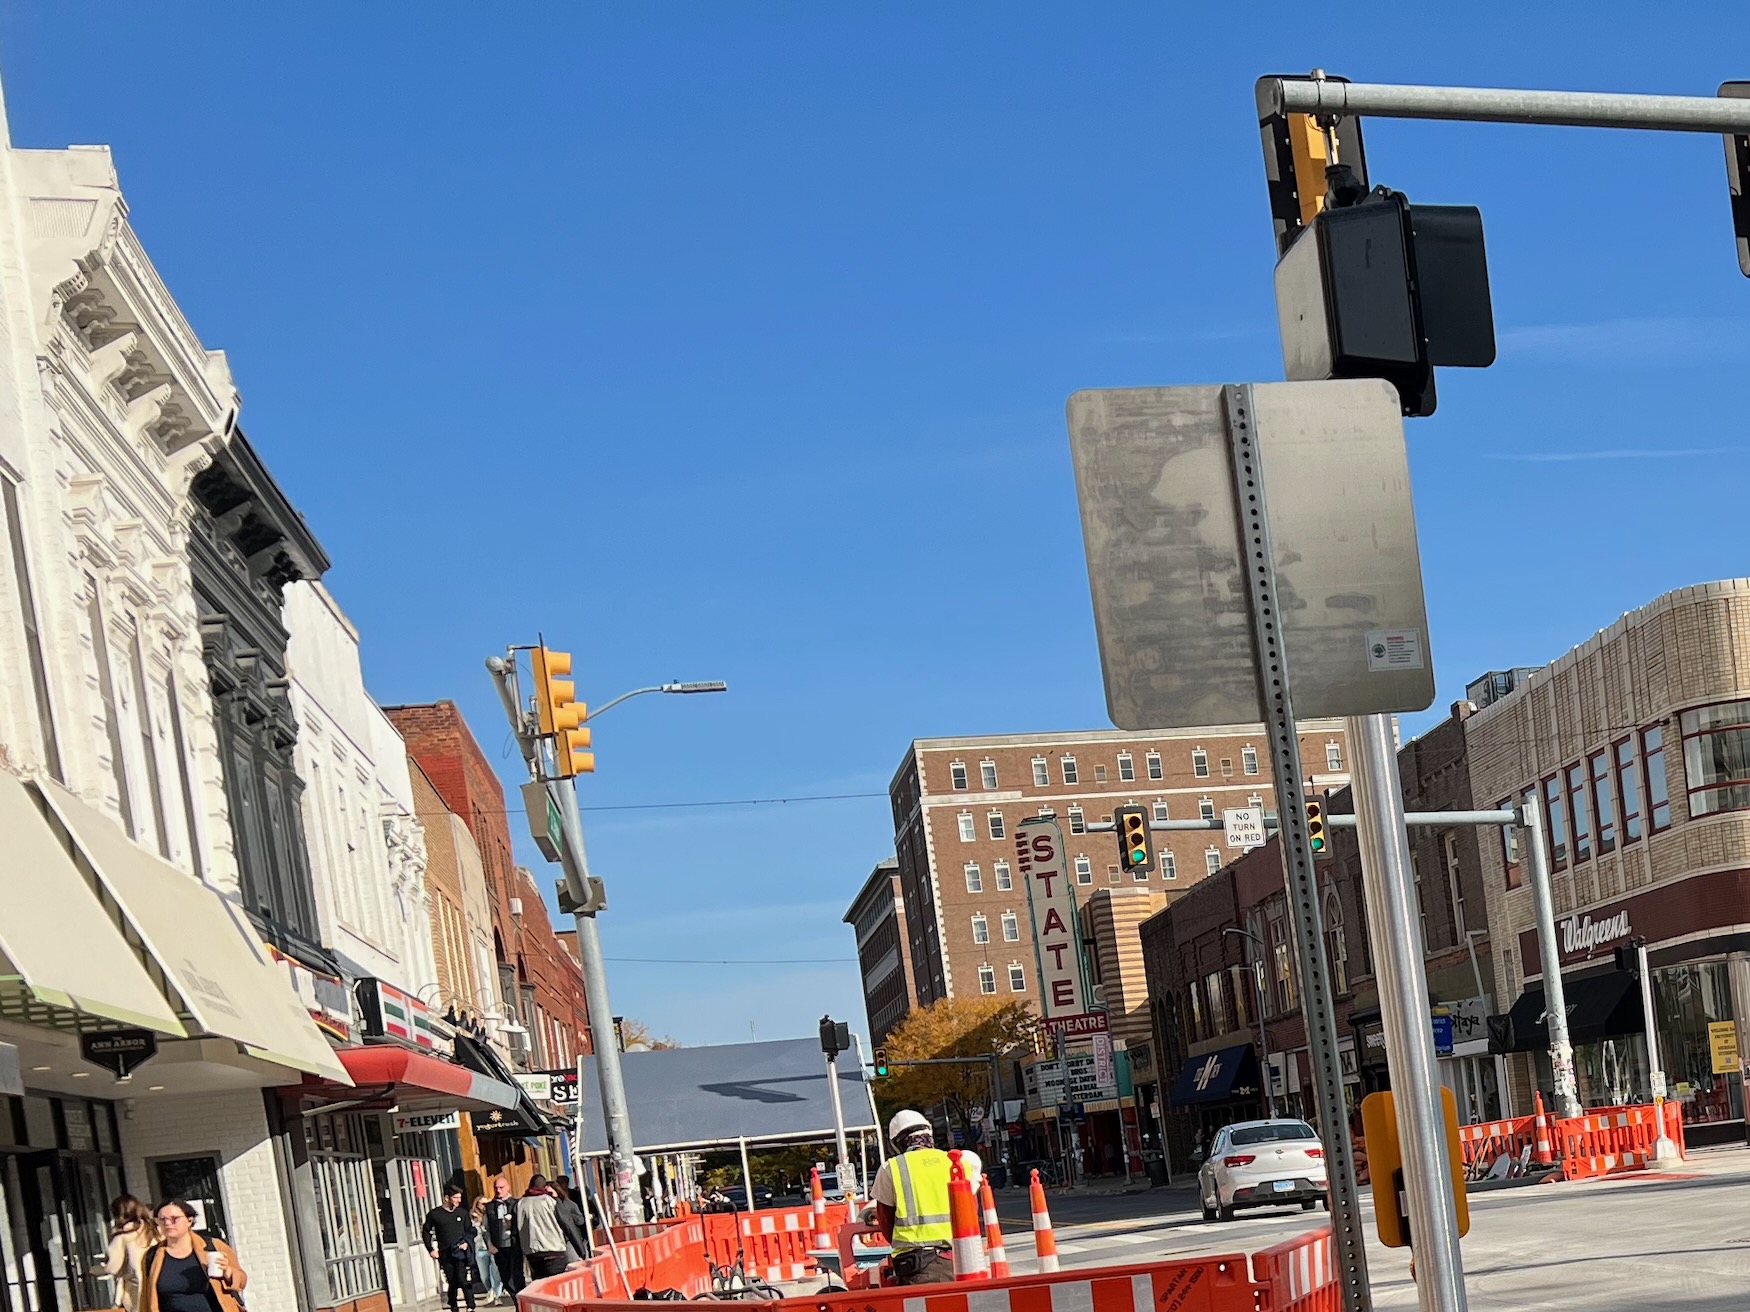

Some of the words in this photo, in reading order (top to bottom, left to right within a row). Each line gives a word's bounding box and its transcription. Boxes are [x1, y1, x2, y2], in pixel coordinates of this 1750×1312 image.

[1235, 812, 1249, 820] NO
[1232, 823, 1255, 831] TURN
[1230, 834, 1241, 842] ON
[1244, 833, 1261, 842] RED
[1031, 834, 1075, 1007] STATE
[1560, 910, 1632, 959] Walgreens
[1051, 1015, 1106, 1034] THEATRE
[90, 1039, 111, 1050] ANN
[111, 1038, 146, 1048] ARBOR
[1096, 1038, 1107, 1083] DISTRICT
[1160, 1268, 1188, 1303] SPARTAN
